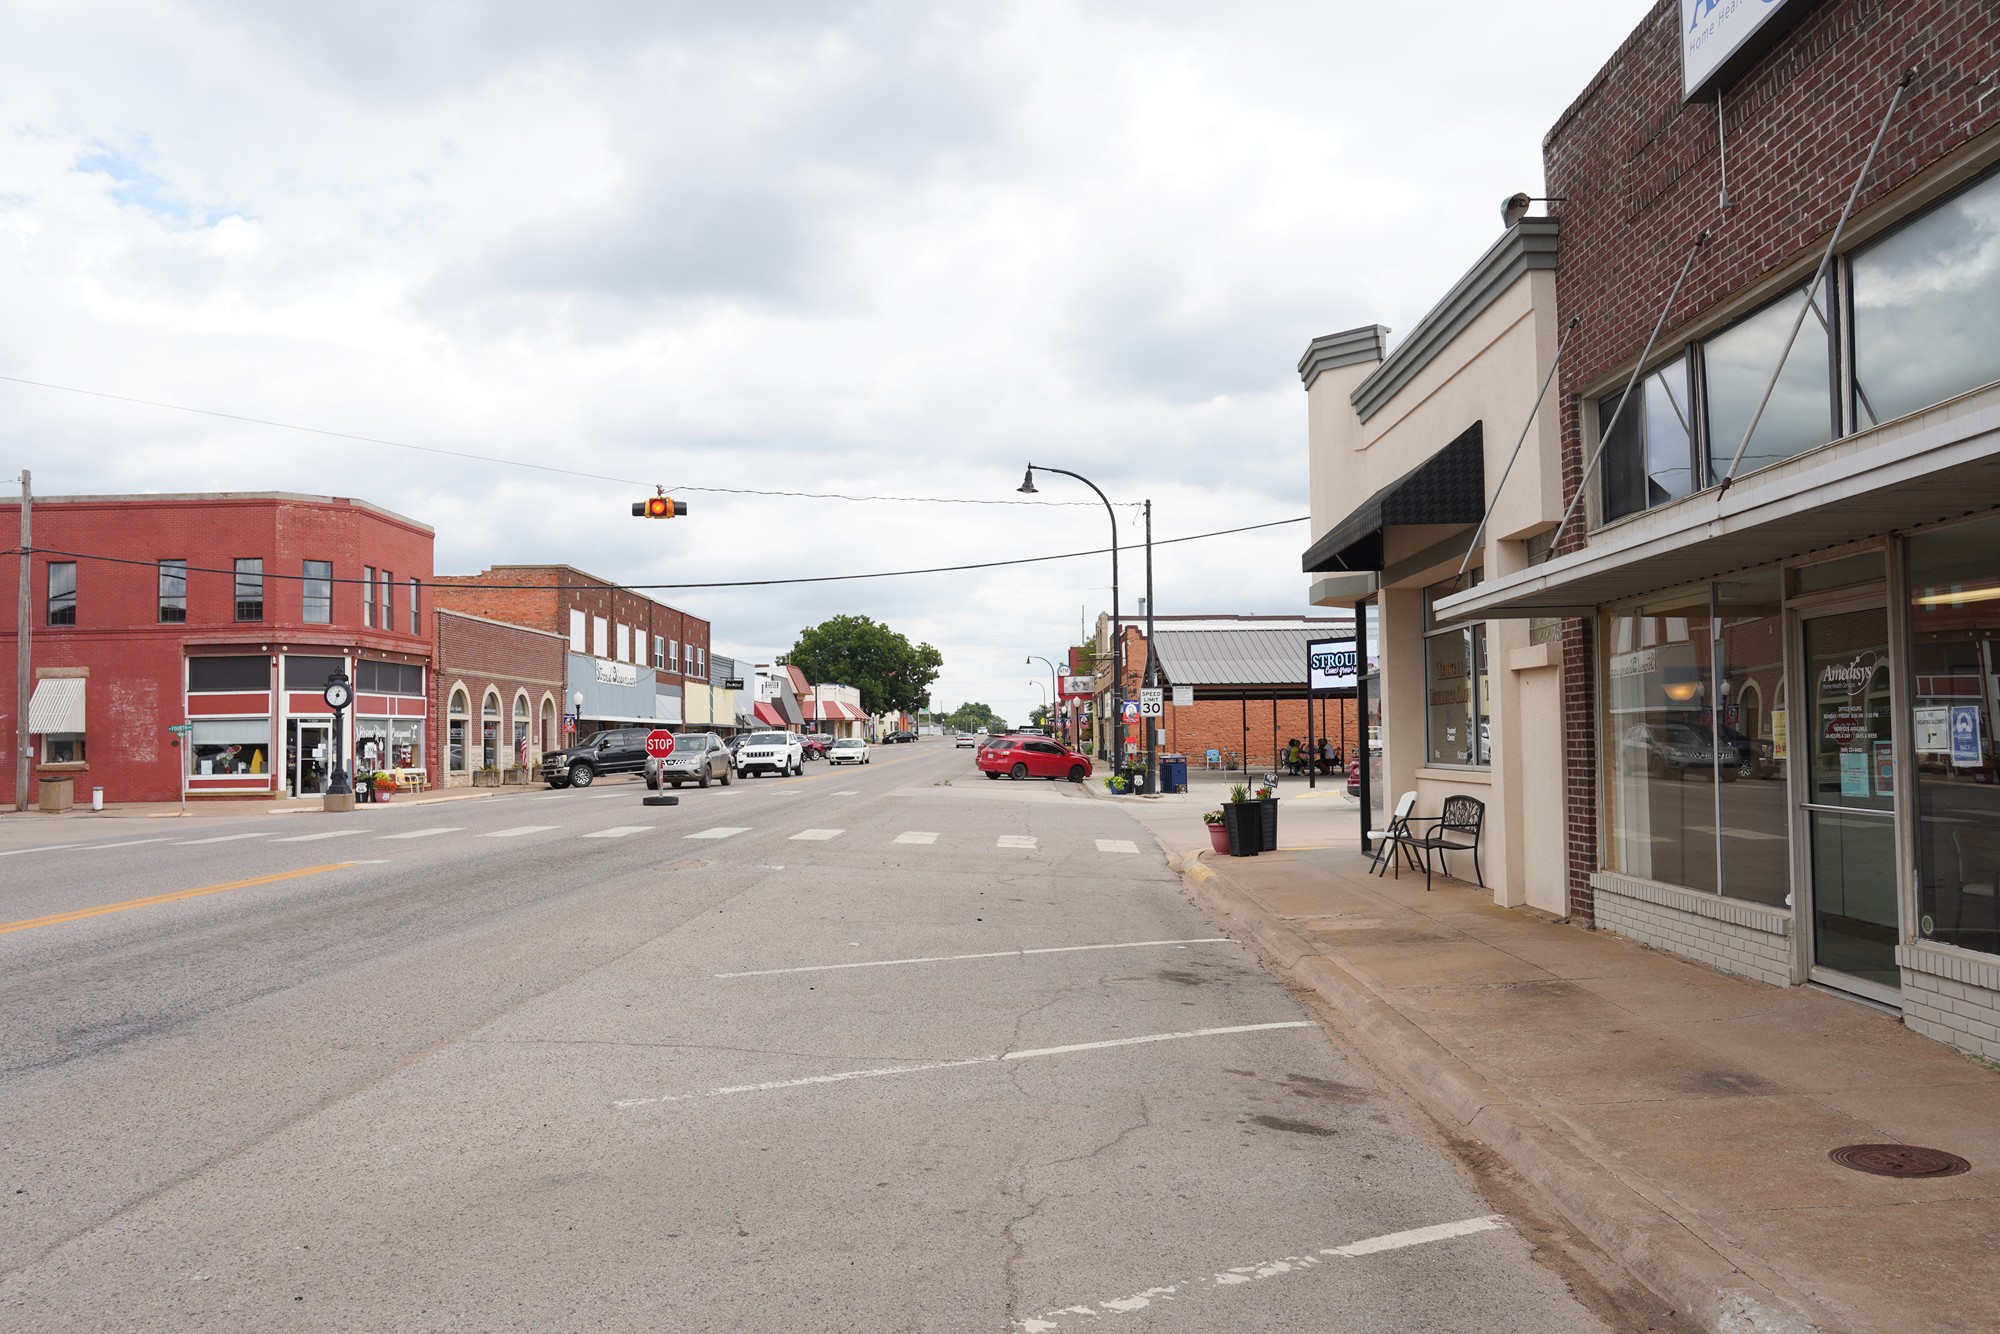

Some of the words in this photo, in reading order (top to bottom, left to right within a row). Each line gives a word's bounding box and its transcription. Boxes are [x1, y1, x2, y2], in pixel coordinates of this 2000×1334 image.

[1689, 23, 1715, 57] Home
[1718, 0, 1743, 26] Heal
[1823, 659, 1872, 686] Amedisys
[1143, 703, 1161, 714] 30
[647, 738, 673, 750] STOP
